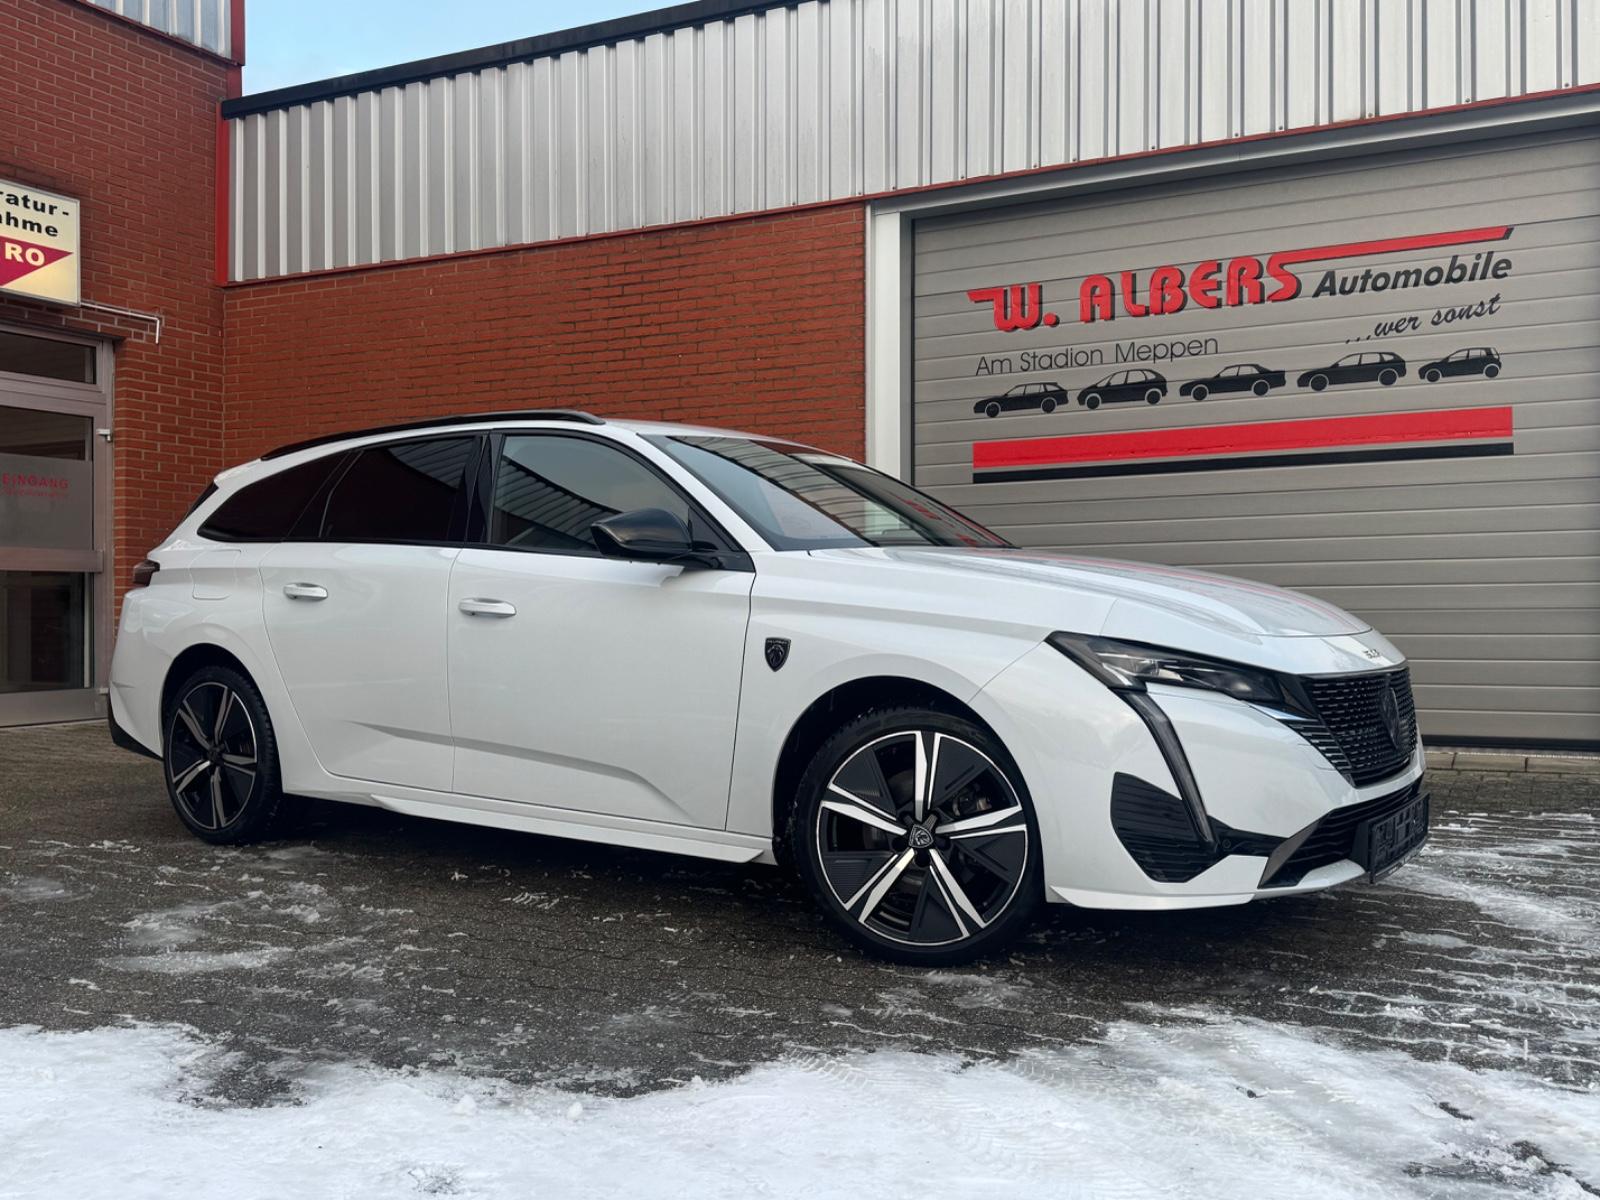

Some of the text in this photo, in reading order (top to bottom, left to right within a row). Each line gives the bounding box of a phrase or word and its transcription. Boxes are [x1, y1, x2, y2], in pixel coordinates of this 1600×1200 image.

[0, 211, 58, 237] hme
[966, 251, 1512, 332] W. ALBERS Automobile
[1431, 293, 1501, 327] sonst
[975, 337, 1219, 376] Am Stadion Meppen
